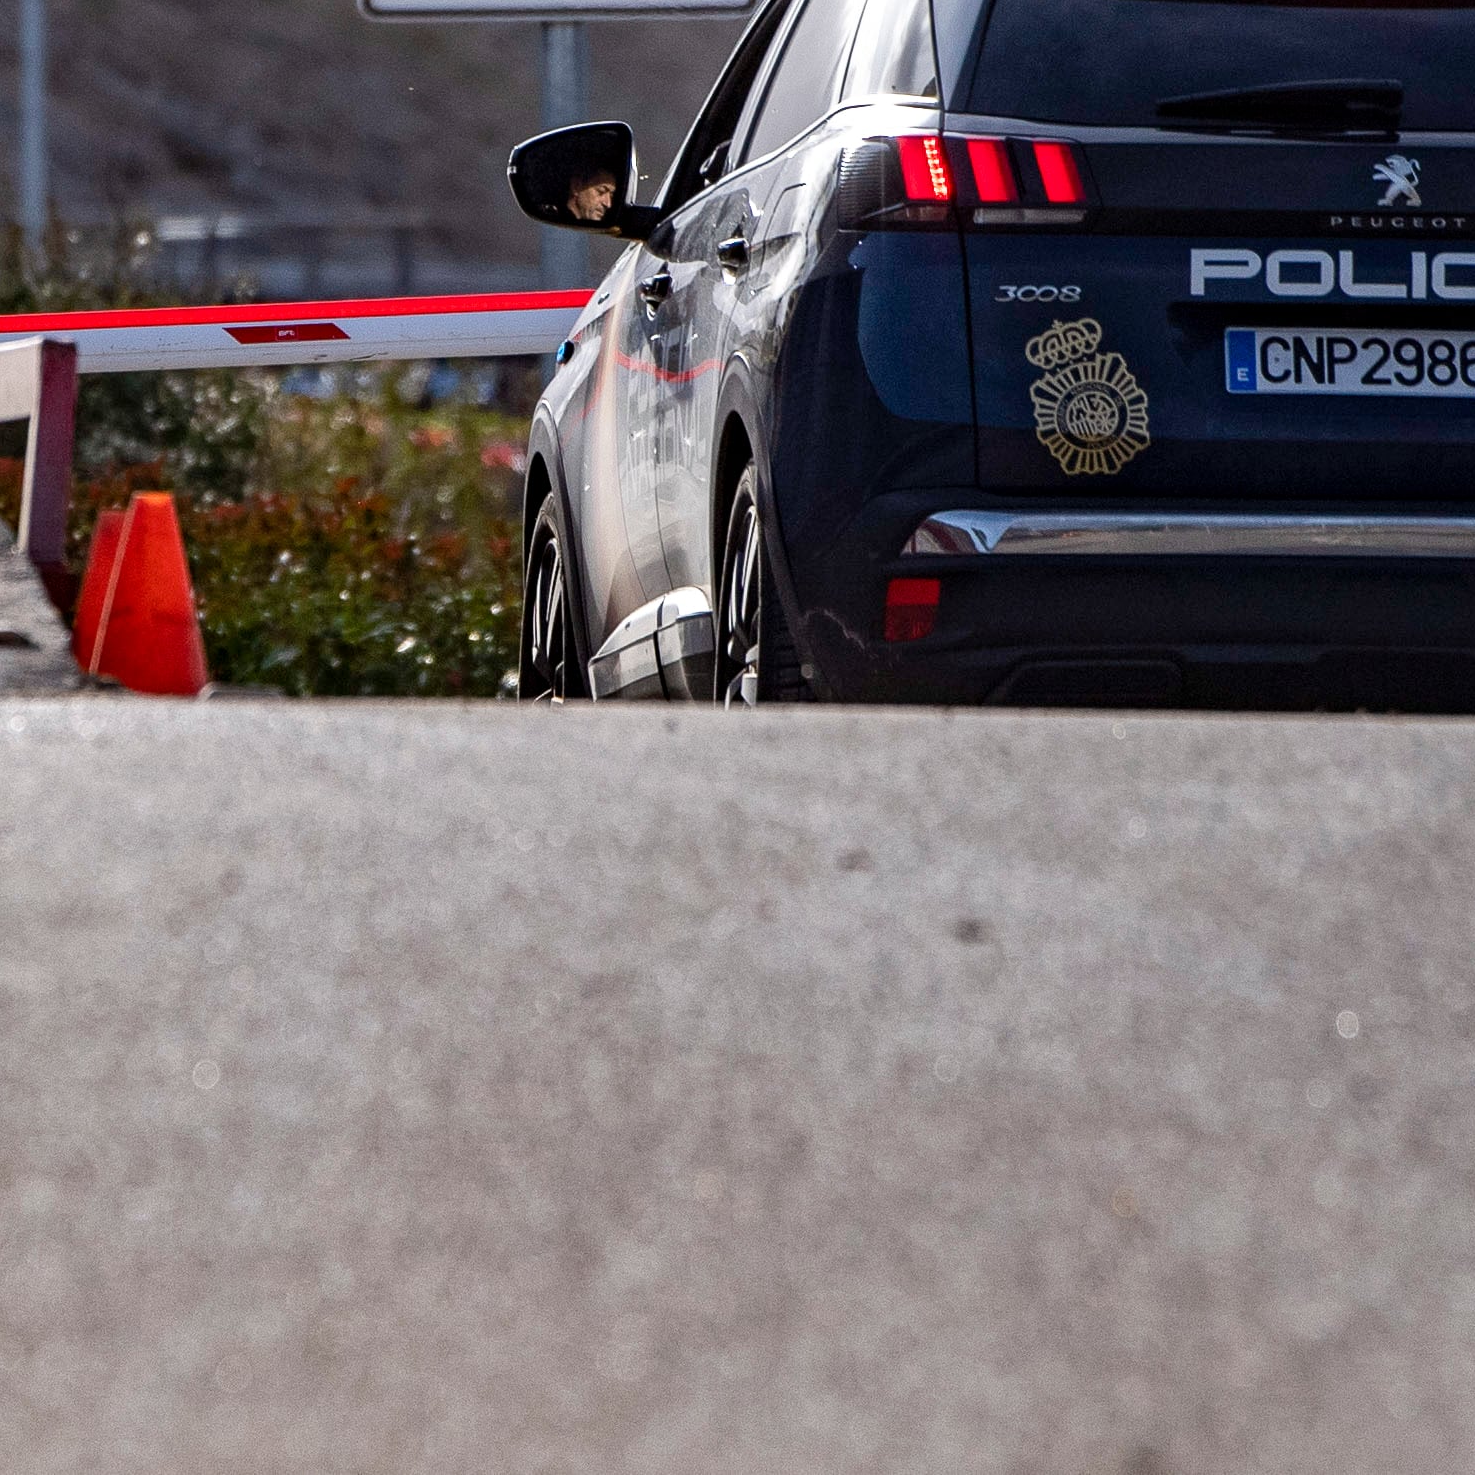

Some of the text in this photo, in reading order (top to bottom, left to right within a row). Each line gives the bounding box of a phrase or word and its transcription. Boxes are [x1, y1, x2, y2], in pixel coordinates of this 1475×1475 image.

[1329, 215, 1467, 228] PEUGEOT
[993, 285, 1082, 302] 3008
[1236, 367, 1250, 382] E
